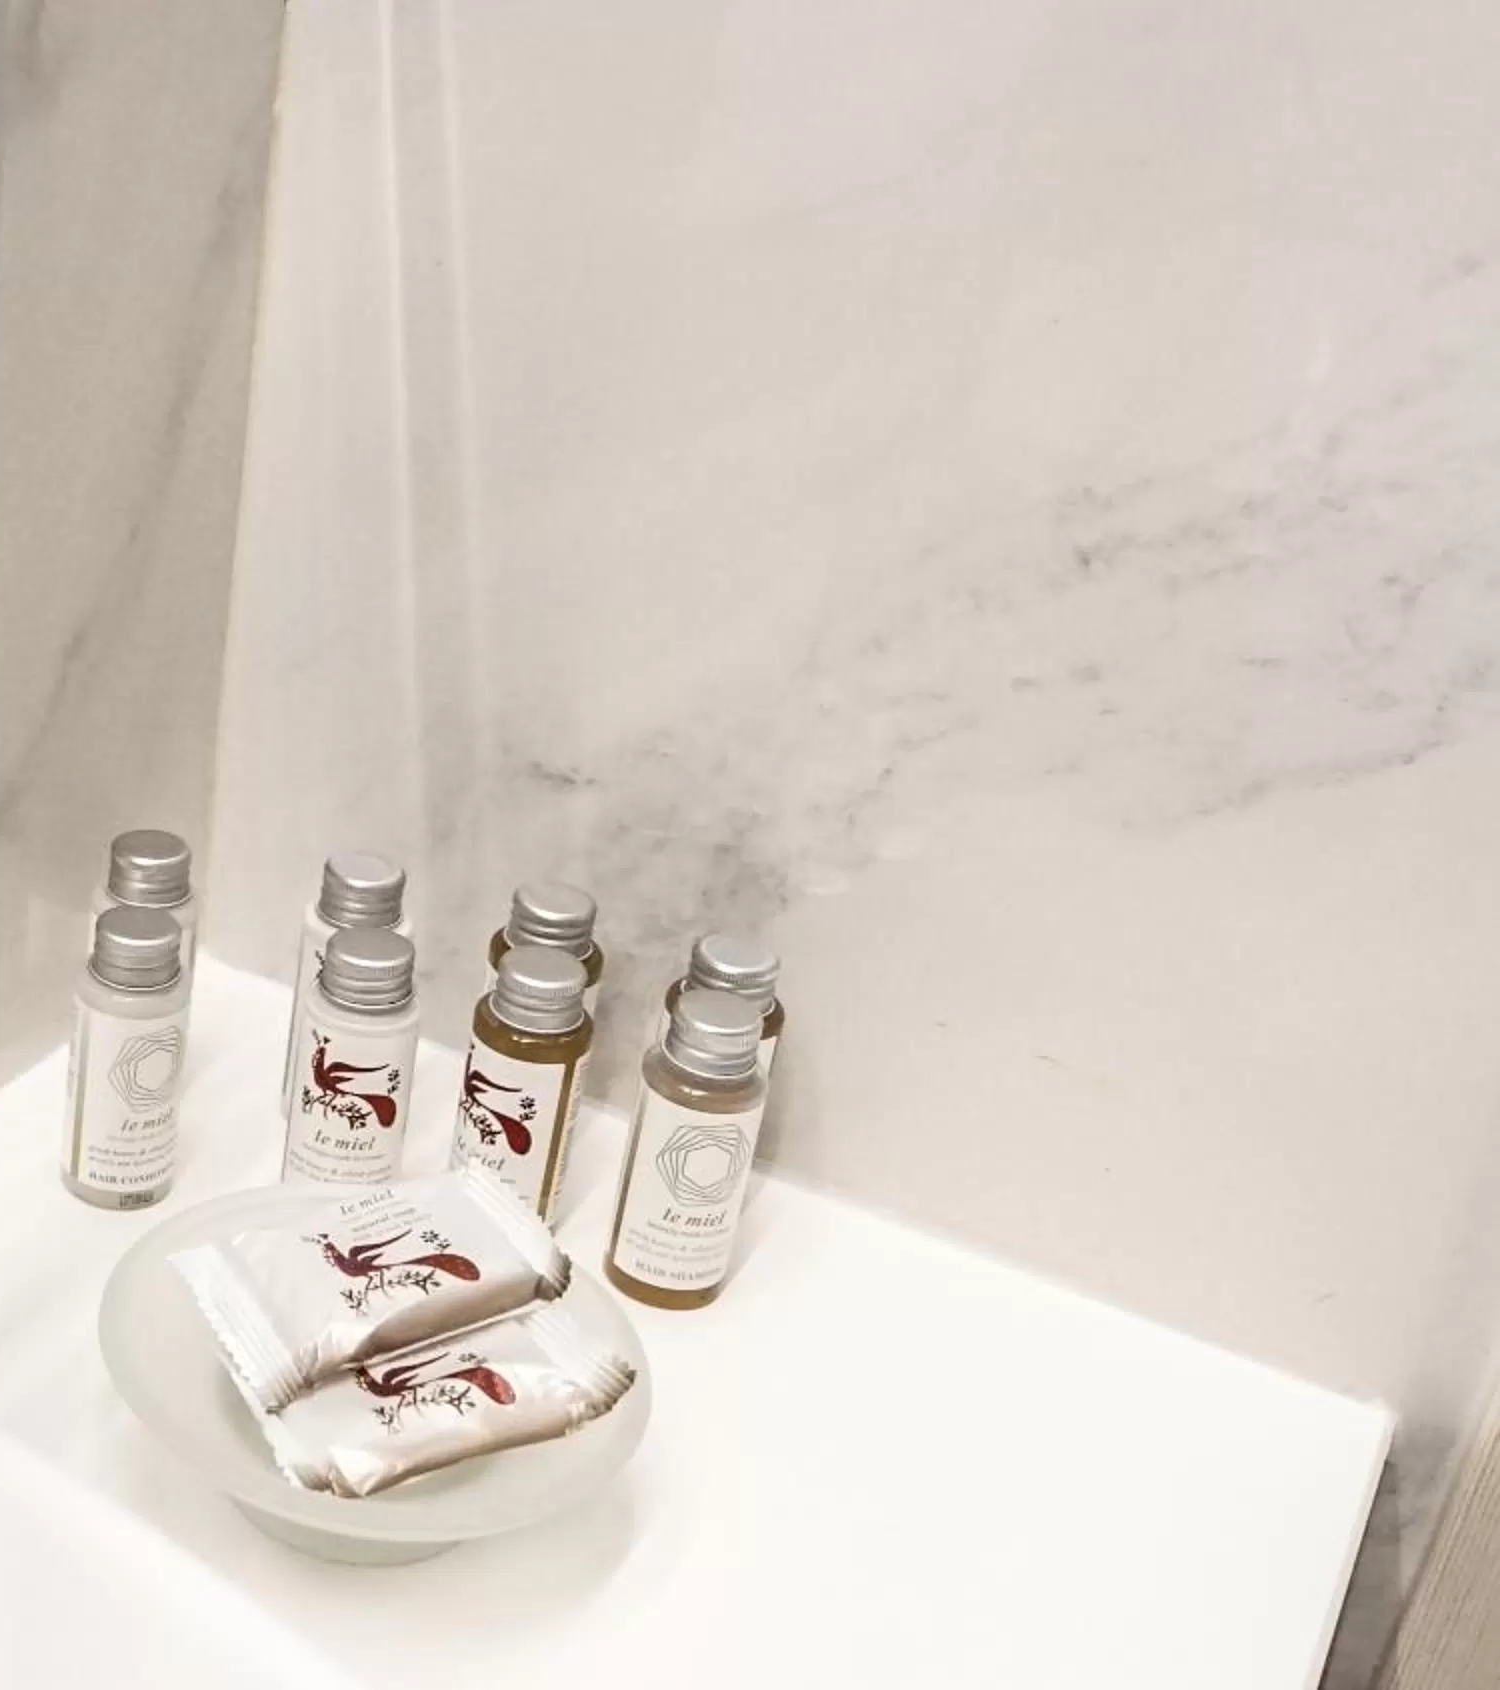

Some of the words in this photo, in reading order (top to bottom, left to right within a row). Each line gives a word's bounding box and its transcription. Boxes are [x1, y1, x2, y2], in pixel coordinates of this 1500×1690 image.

[120, 1119, 139, 1132] le
[315, 1129, 331, 1144] le
[334, 1136, 376, 1151] miel
[340, 1203, 355, 1216] le
[662, 1208, 681, 1223] le
[684, 1209, 728, 1227] miel
